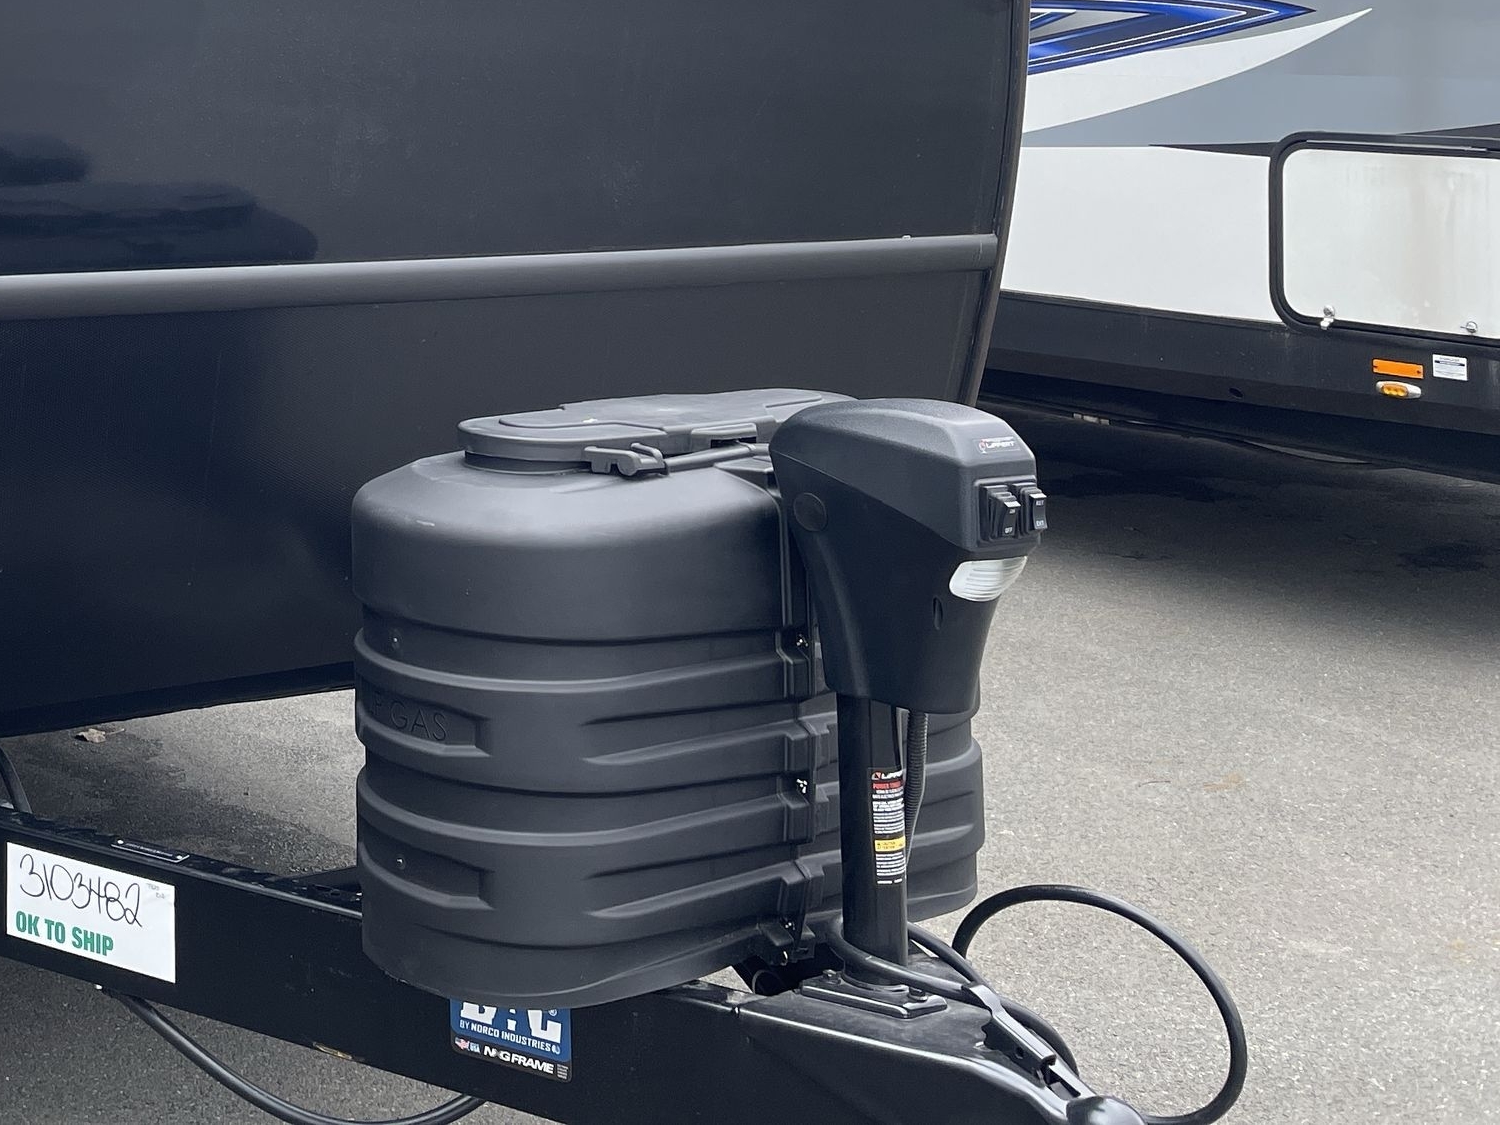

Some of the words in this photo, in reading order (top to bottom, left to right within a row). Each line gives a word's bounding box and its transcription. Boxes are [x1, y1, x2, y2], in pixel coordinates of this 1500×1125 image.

[390, 700, 447, 742] GAS
[19, 853, 143, 928] 3103482
[15, 910, 40, 937] OK
[44, 918, 66, 944] TO
[71, 926, 114, 957] SHIP
[460, 1019, 470, 1030] BY
[470, 1022, 500, 1038] NORCO
[501, 1030, 551, 1053] INDUSTRIES
